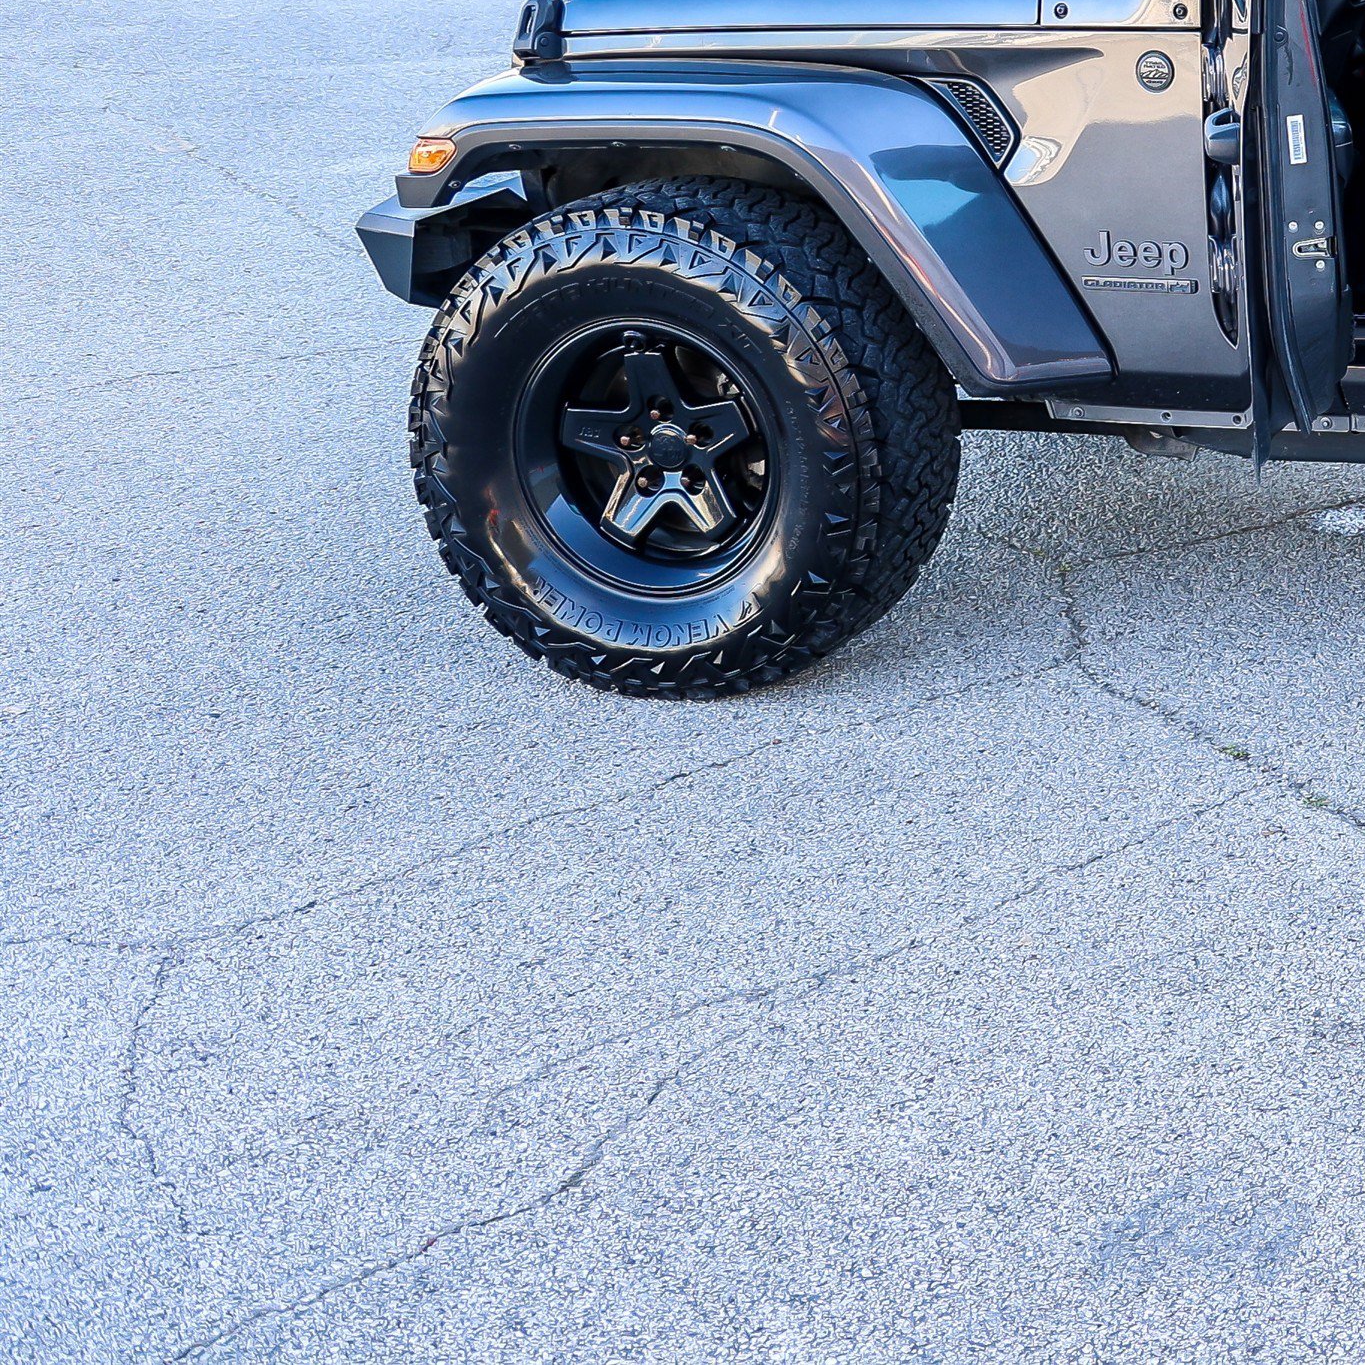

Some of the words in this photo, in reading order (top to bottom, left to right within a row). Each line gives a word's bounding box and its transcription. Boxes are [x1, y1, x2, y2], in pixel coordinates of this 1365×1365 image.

[1083, 229, 1189, 276] Jeep
[1083, 278, 1167, 290] GLADIATOR
[532, 575, 625, 644] POWER
[626, 612, 730, 648] VENOM
